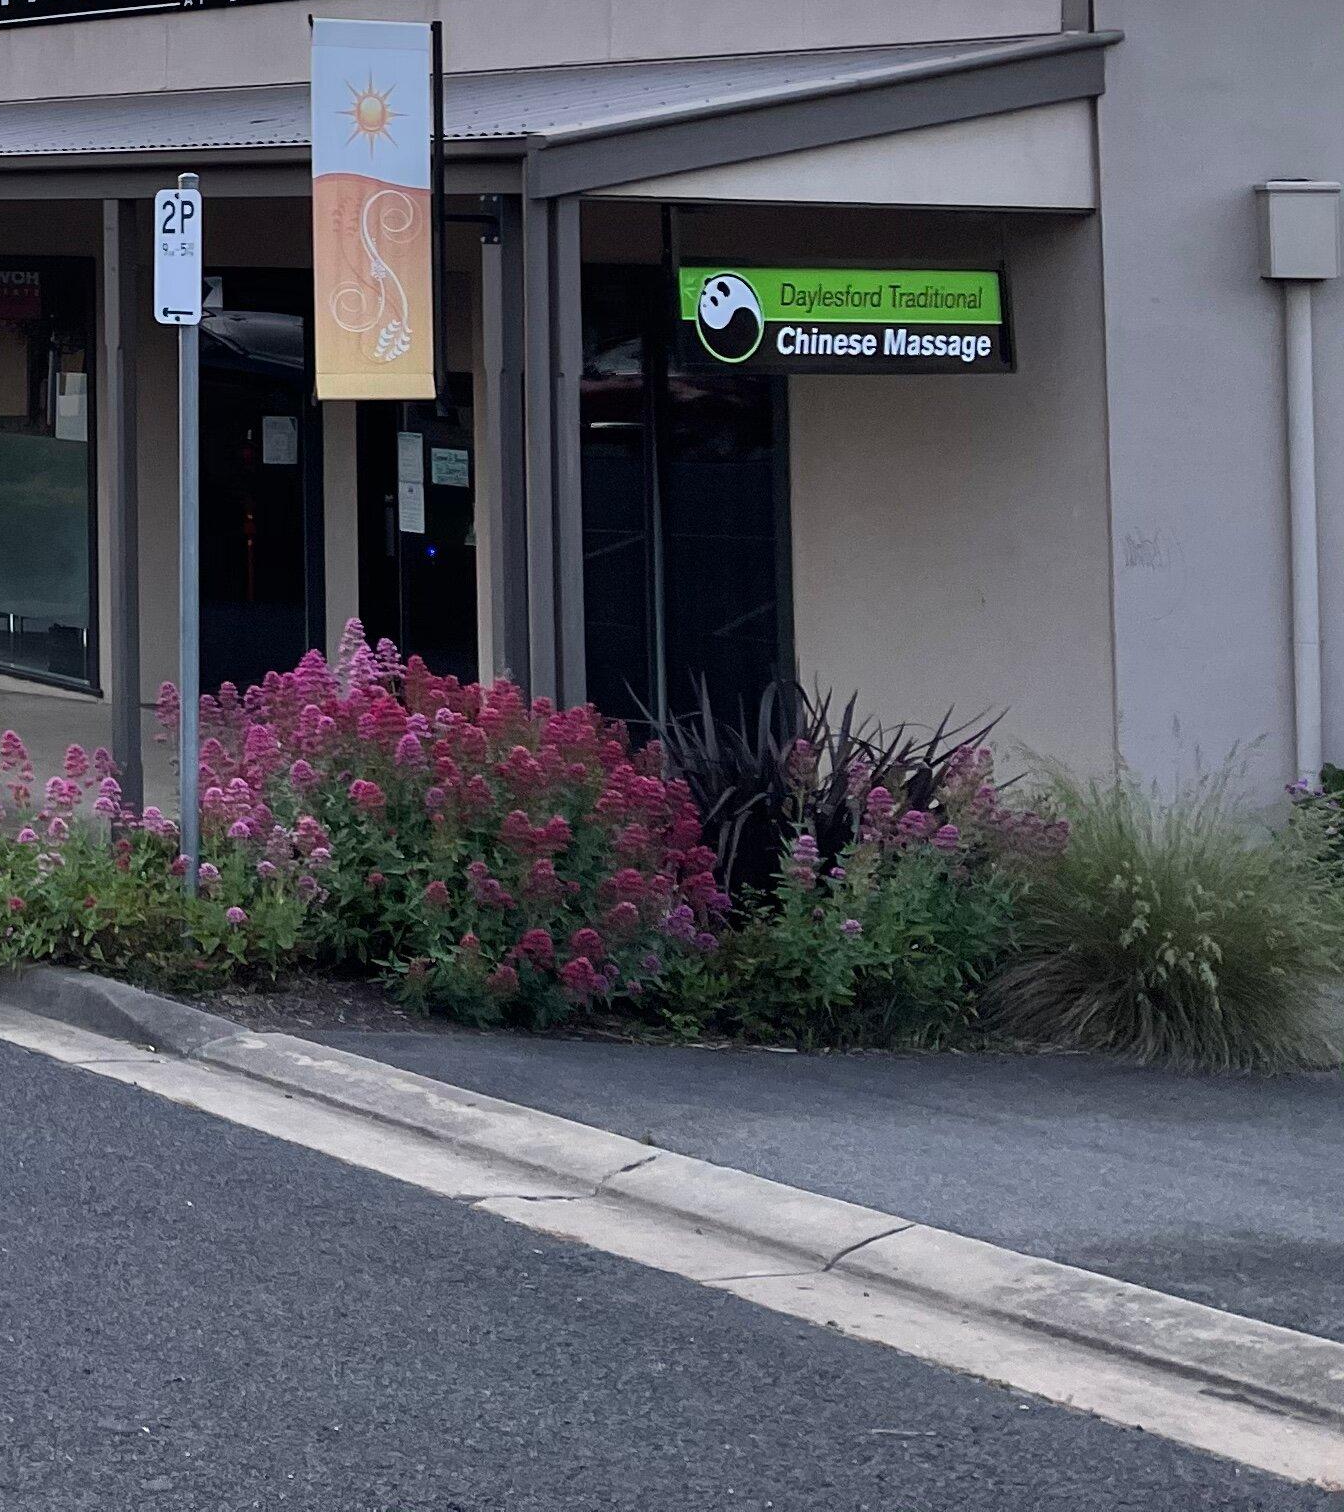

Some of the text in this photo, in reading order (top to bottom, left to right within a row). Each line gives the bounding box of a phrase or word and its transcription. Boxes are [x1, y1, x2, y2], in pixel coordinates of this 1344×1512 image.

[162, 199, 194, 234] 2P
[780, 282, 983, 313] Daylesford Traditional
[777, 326, 992, 362] Chinese Massage
